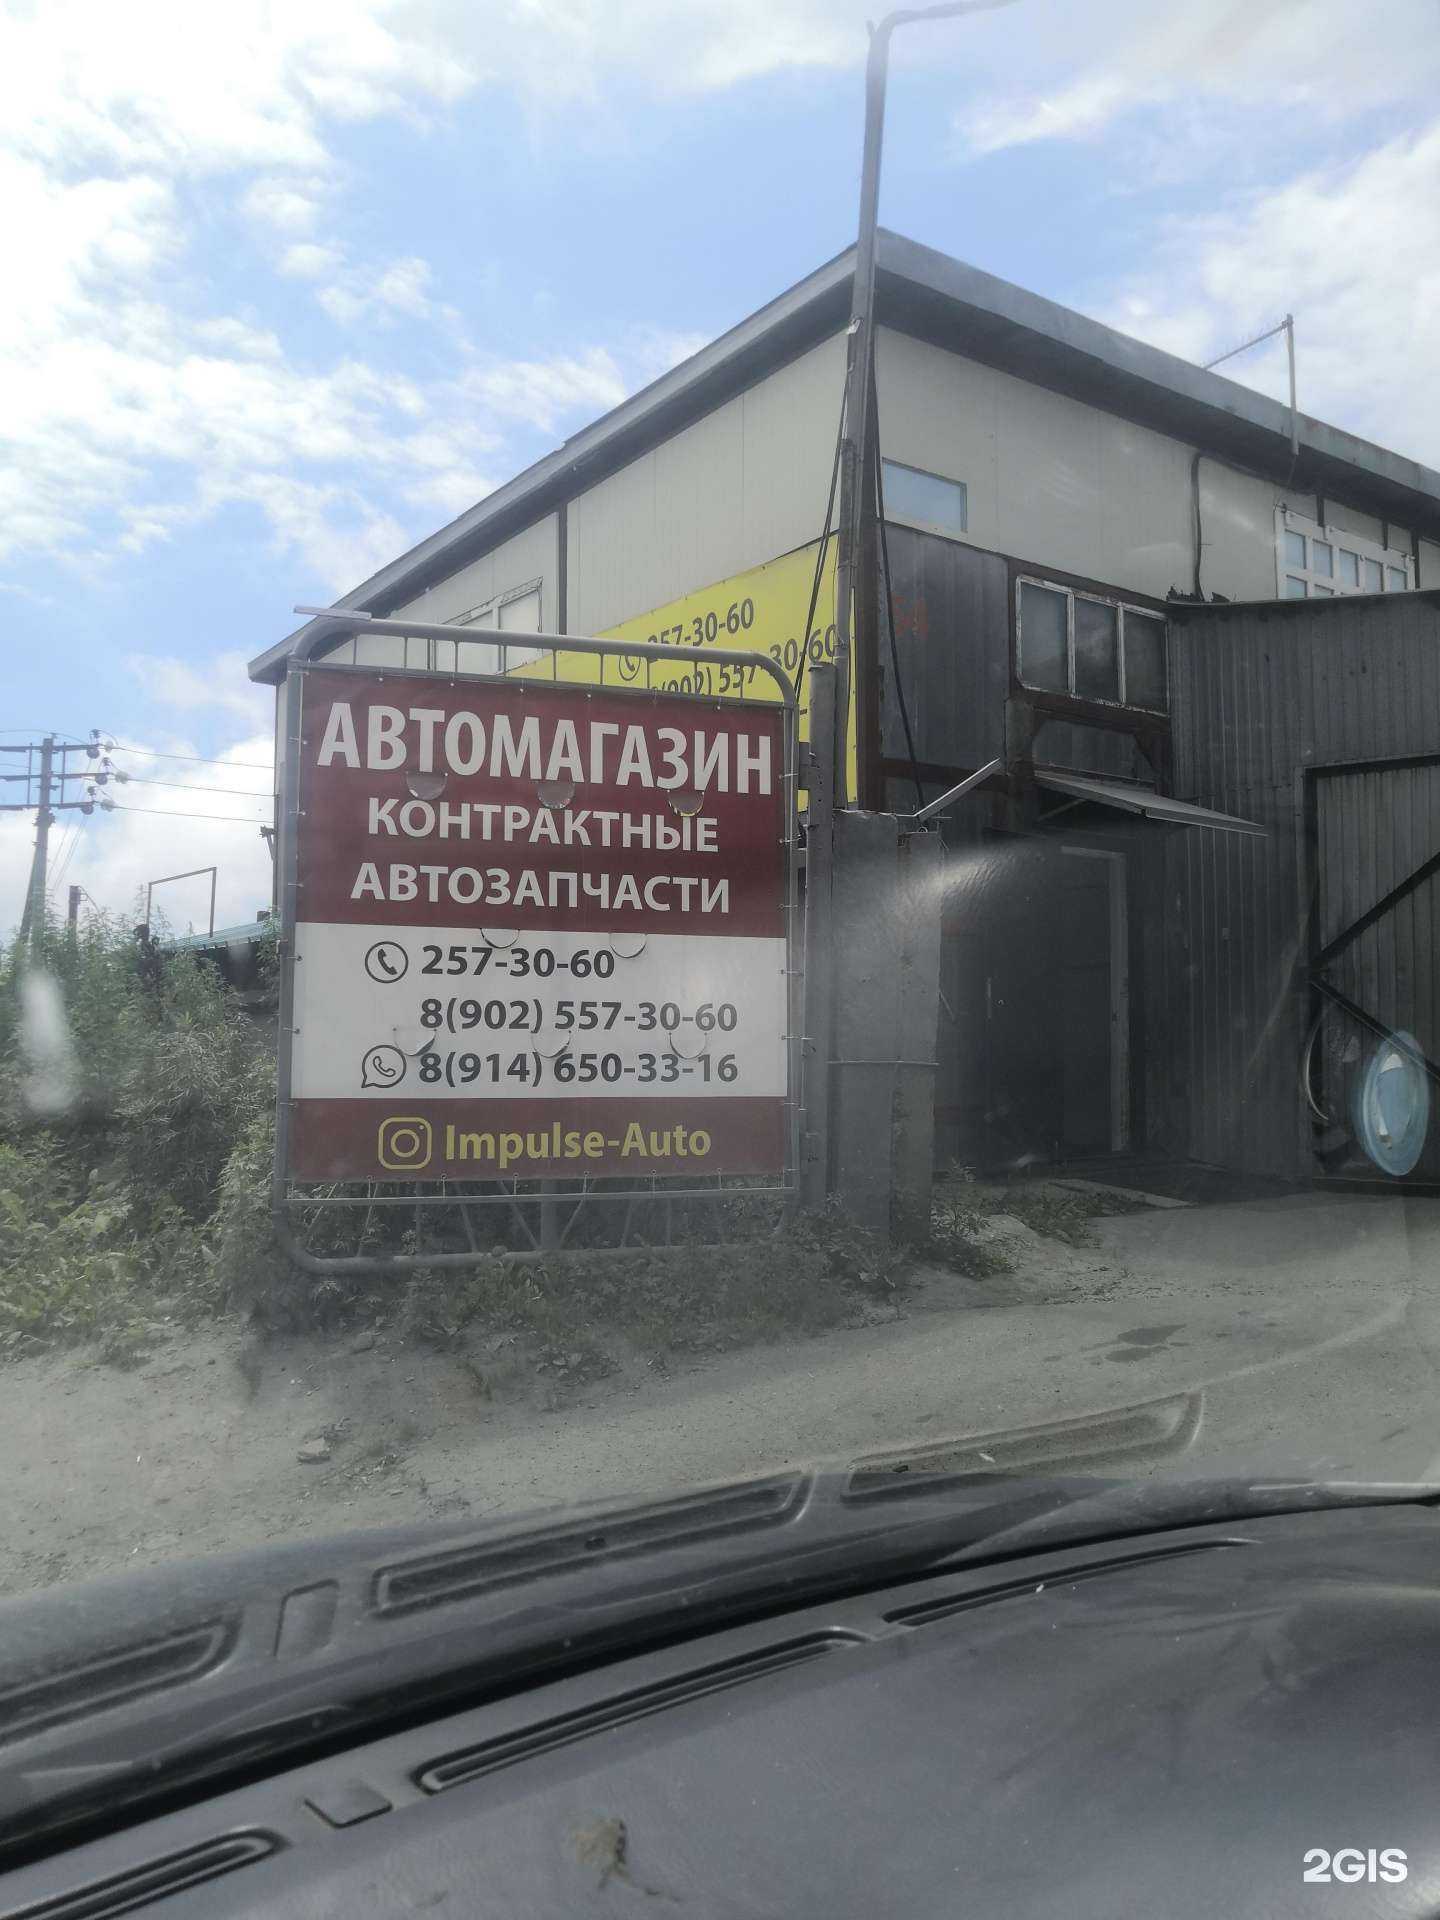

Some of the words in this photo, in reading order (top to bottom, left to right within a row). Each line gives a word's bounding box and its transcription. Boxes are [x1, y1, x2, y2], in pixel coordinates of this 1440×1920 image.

[317, 702, 772, 795] АВТОМАГАЗИН
[368, 797, 720, 853] КОНТРАКТНЫЕ
[350, 862, 730, 914] АВТОЗАПЧАСТИ
[420, 945, 616, 979] 257-30-60
[419, 998, 543, 1034] 8(902)
[554, 1001, 739, 1032] 557-30-60
[418, 1052, 543, 1088] 8(914)
[553, 1053, 739, 1083] 650-33-16
[446, 1121, 712, 1169] Impulse-Auto
